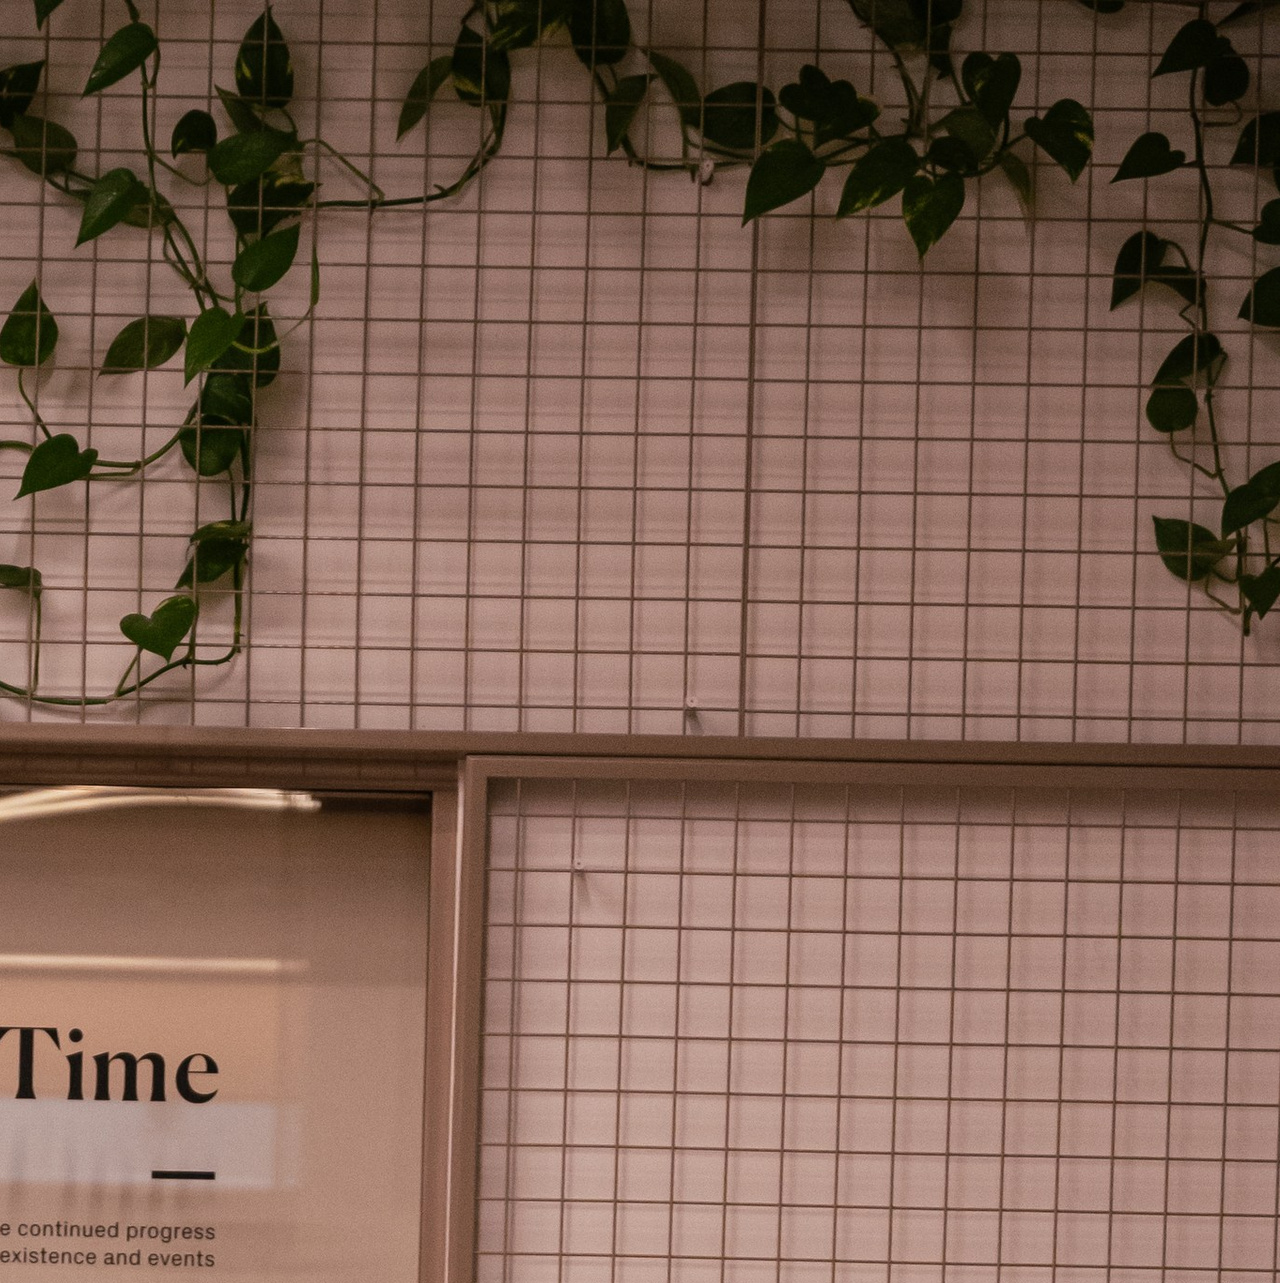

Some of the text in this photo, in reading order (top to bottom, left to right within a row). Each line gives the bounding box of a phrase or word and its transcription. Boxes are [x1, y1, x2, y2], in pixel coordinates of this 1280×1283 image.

[17, 1220, 119, 1239] continued
[126, 1224, 216, 1243] progress
[0, 1248, 97, 1266] existence
[104, 1249, 141, 1266] and
[148, 1251, 216, 1268] events
